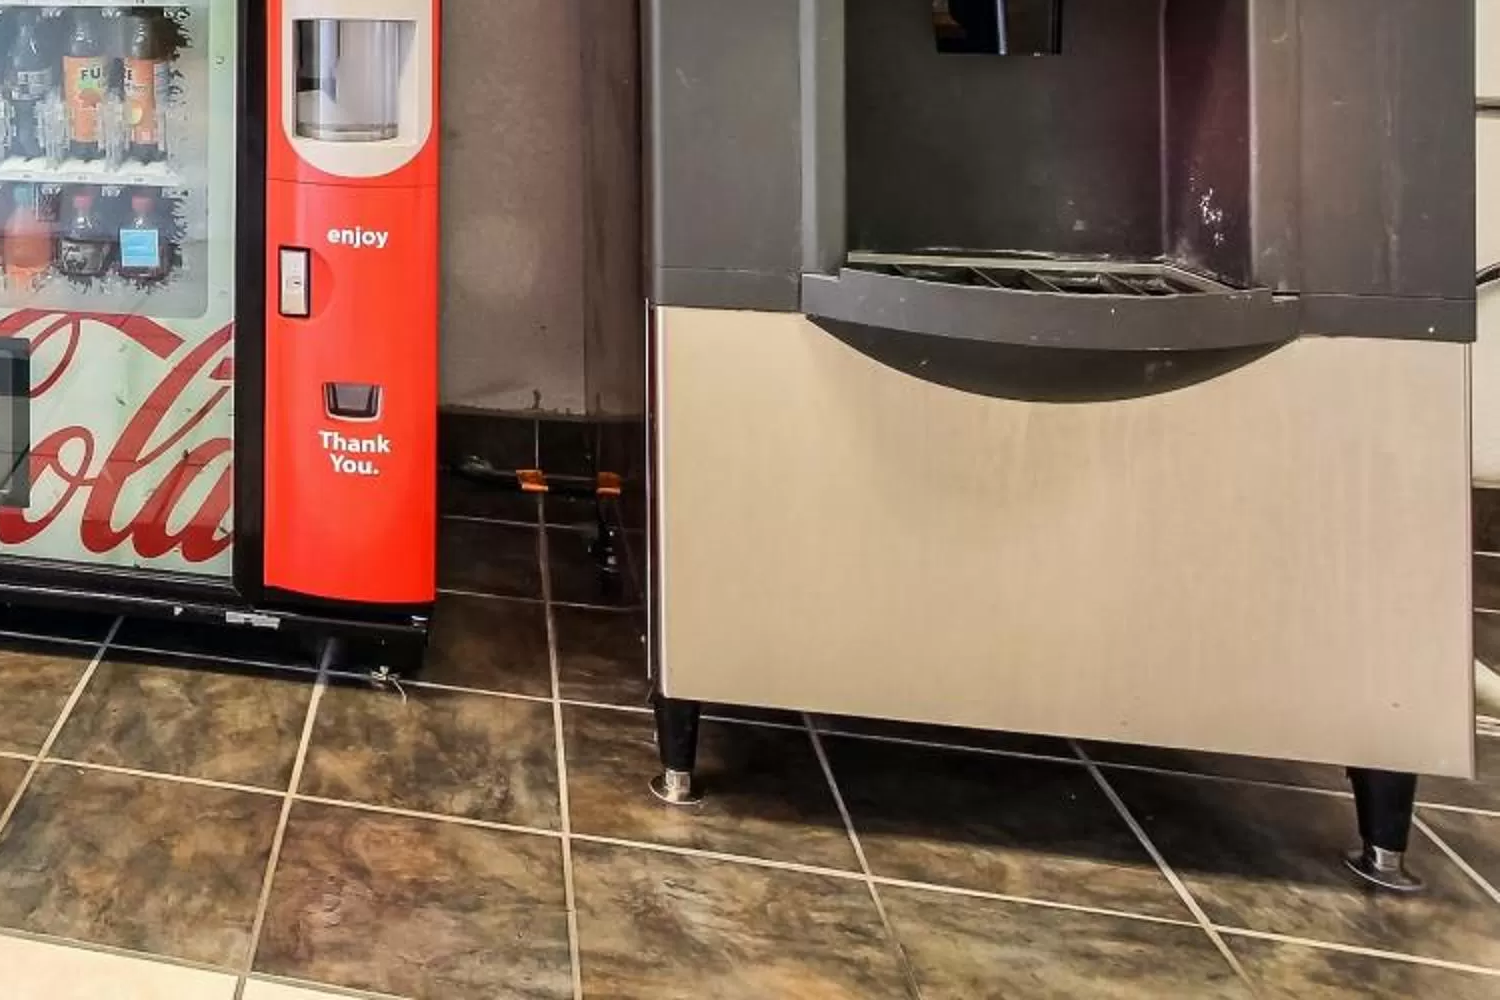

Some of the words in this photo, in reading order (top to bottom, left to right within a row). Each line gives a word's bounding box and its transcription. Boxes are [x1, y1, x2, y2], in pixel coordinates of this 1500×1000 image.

[326, 226, 389, 249] enjoy
[318, 430, 391, 454] Thank
[329, 454, 380, 476] You.
